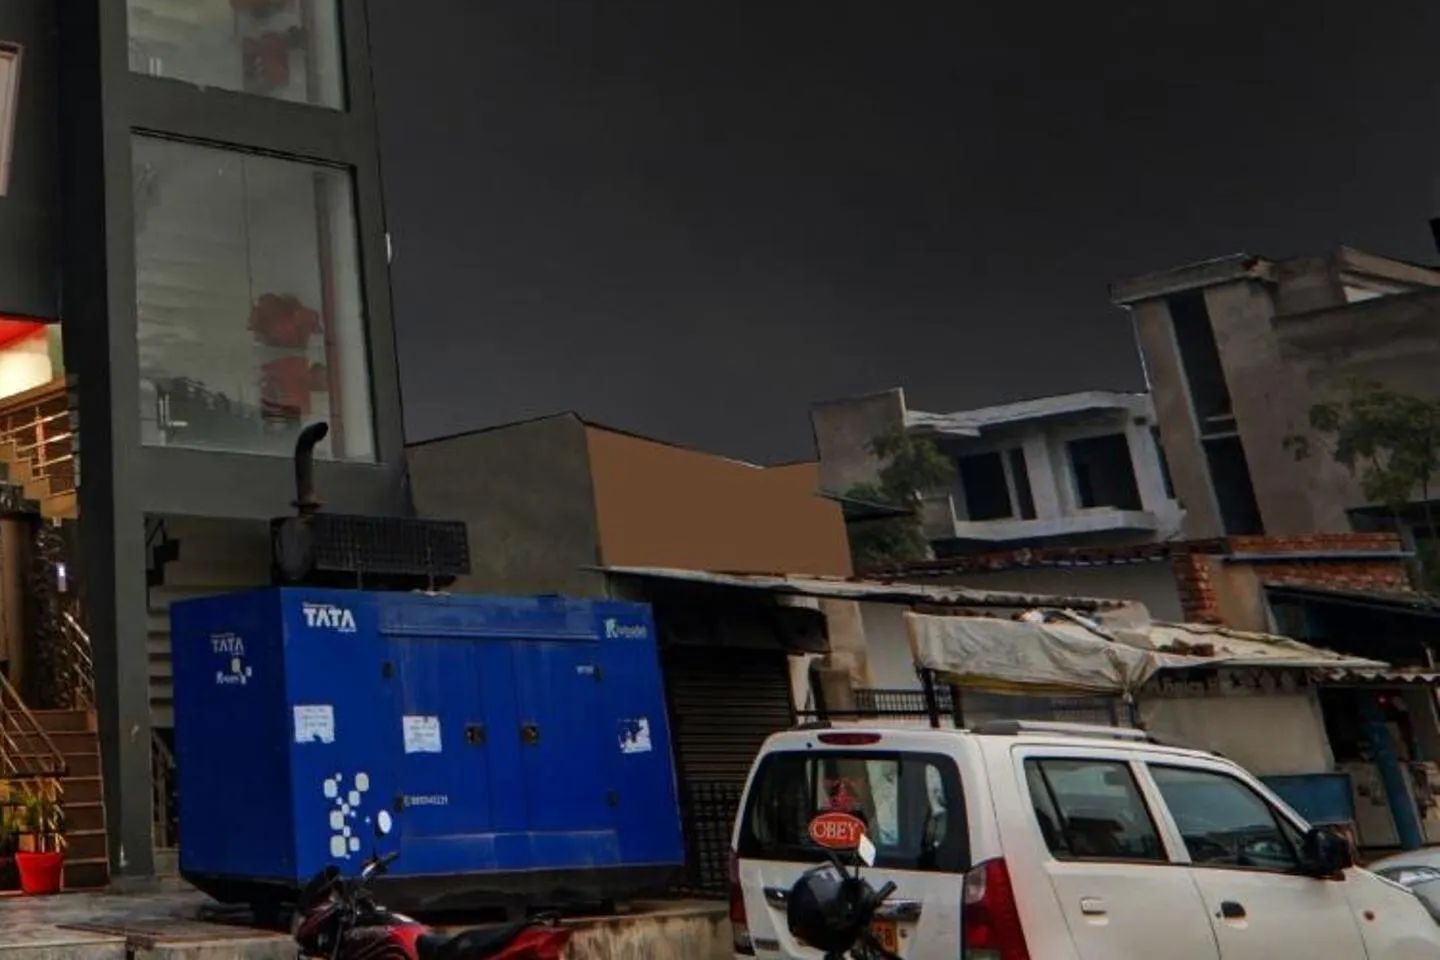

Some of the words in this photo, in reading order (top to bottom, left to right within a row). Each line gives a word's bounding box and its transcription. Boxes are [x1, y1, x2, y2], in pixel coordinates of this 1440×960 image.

[302, 608, 357, 631] TATA
[211, 637, 245, 654] TATA
[813, 822, 860, 841] OBEY
